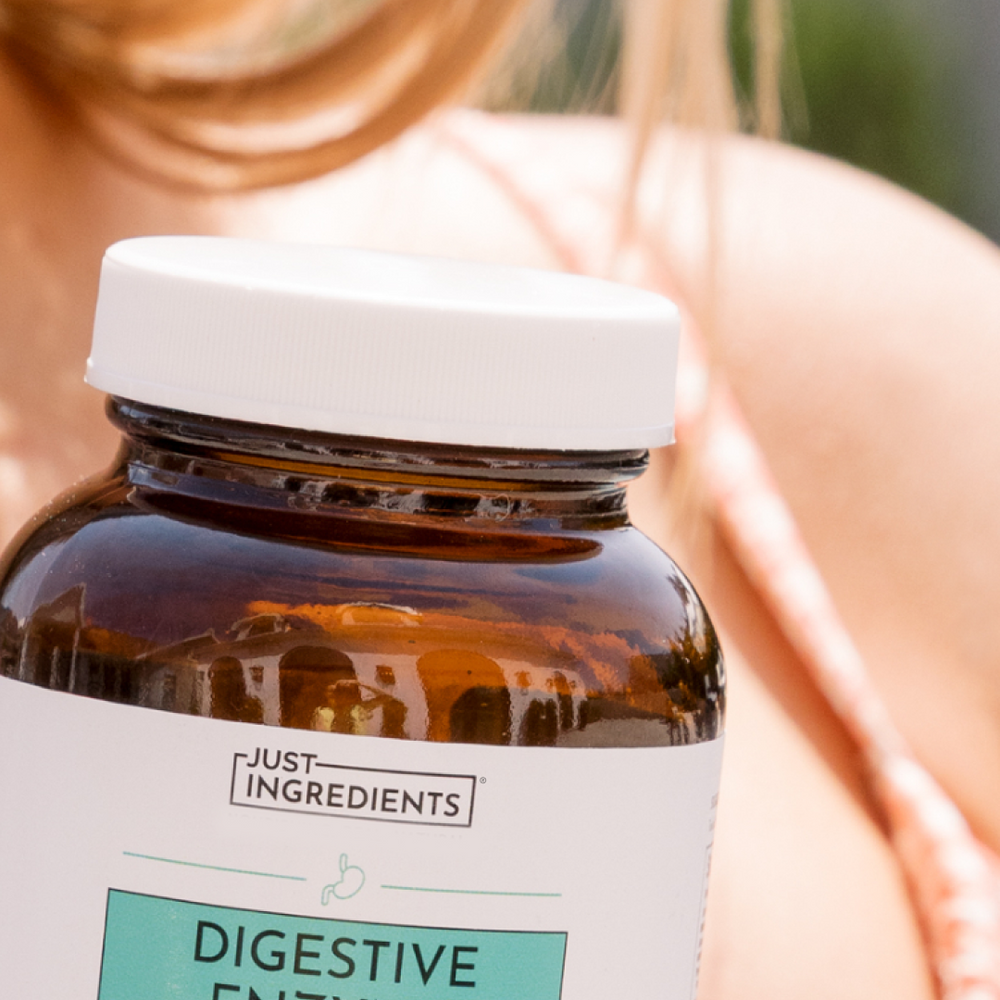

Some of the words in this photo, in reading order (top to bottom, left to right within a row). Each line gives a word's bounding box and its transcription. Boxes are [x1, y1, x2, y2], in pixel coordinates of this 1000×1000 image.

[246, 747, 318, 775] JUST
[246, 773, 460, 817] INGREDIENTS
[193, 919, 479, 988] DIGESTIVE
